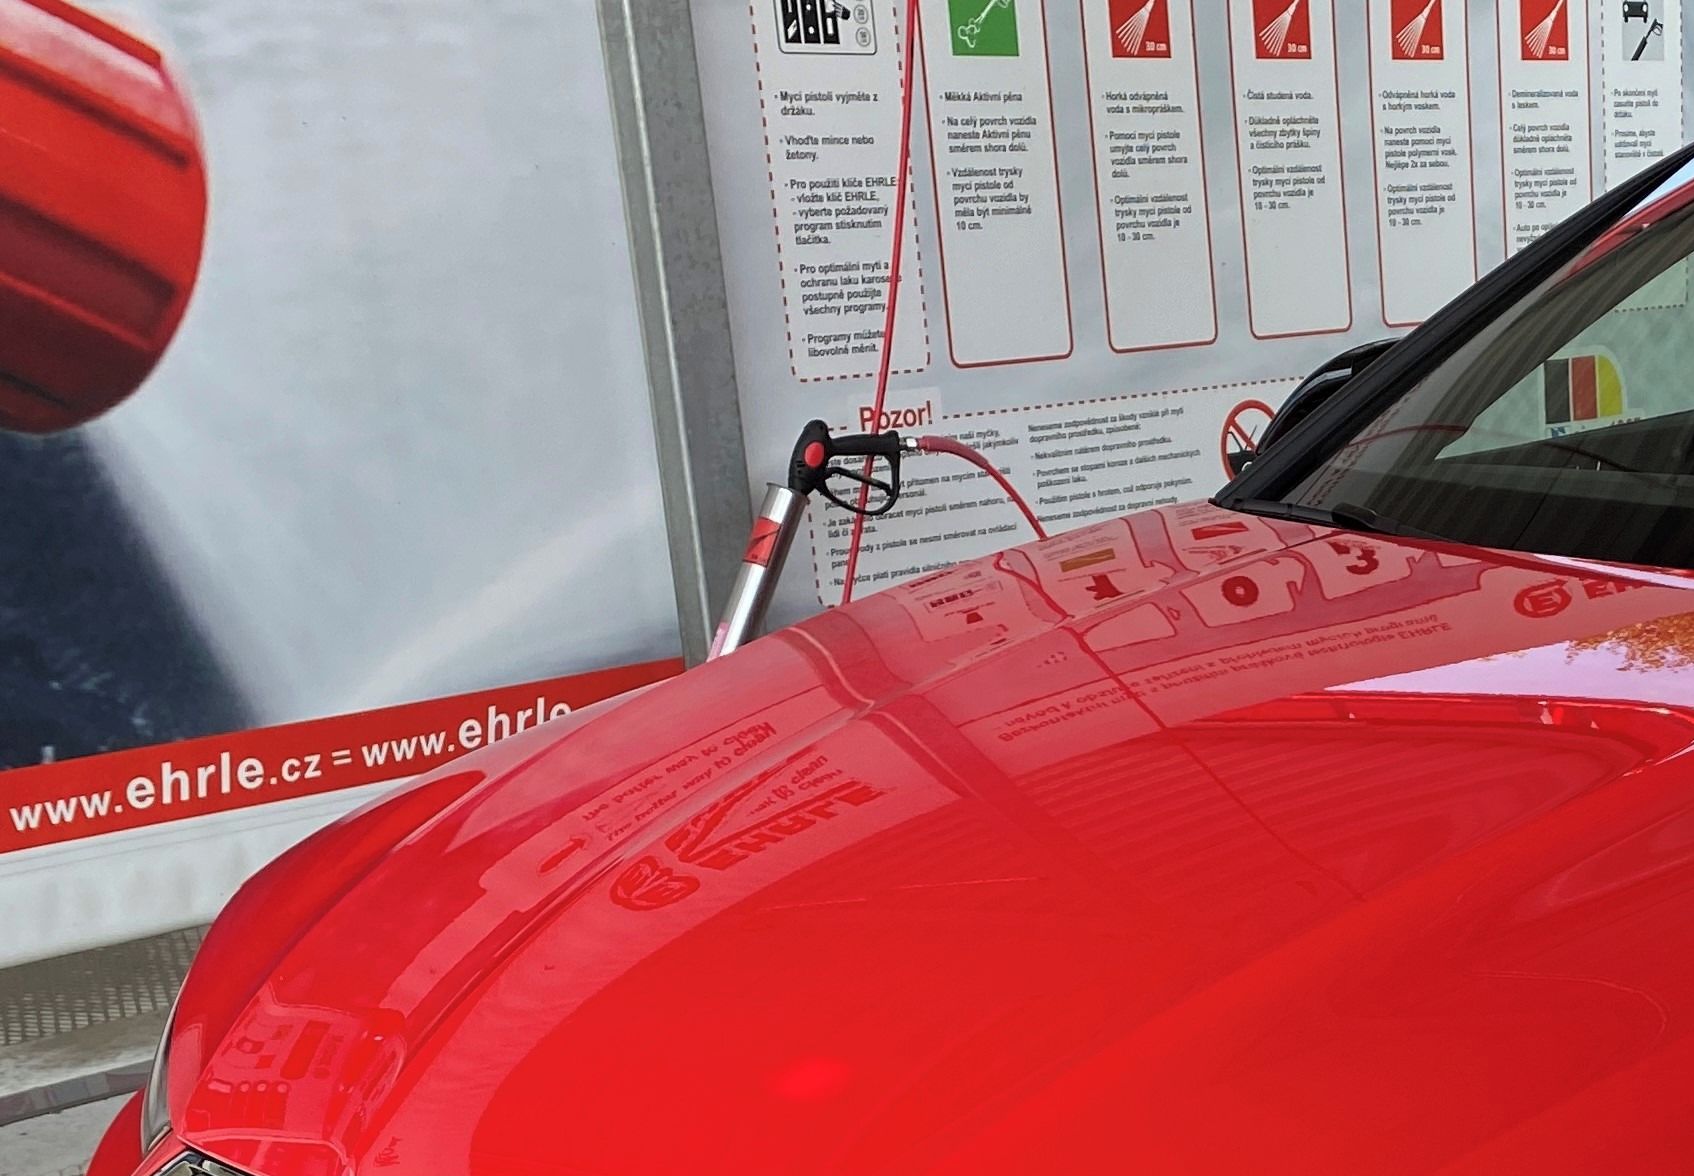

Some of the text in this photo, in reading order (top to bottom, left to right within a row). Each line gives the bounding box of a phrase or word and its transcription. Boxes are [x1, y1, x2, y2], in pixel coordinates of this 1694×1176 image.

[947, 116, 958, 126] Na
[822, 135, 849, 144] mince
[852, 135, 874, 144] nebo
[790, 179, 806, 189] Pro
[1004, 181, 1013, 189] od
[1019, 193, 1029, 204] by
[794, 223, 832, 233] program
[800, 263, 816, 273] Pro
[801, 277, 838, 288] ochranu
[840, 275, 858, 285] laku
[808, 332, 851, 344] Programy
[859, 400, 933, 431] Pozor!
[10, 750, 321, 831] www.ehrle.cz
